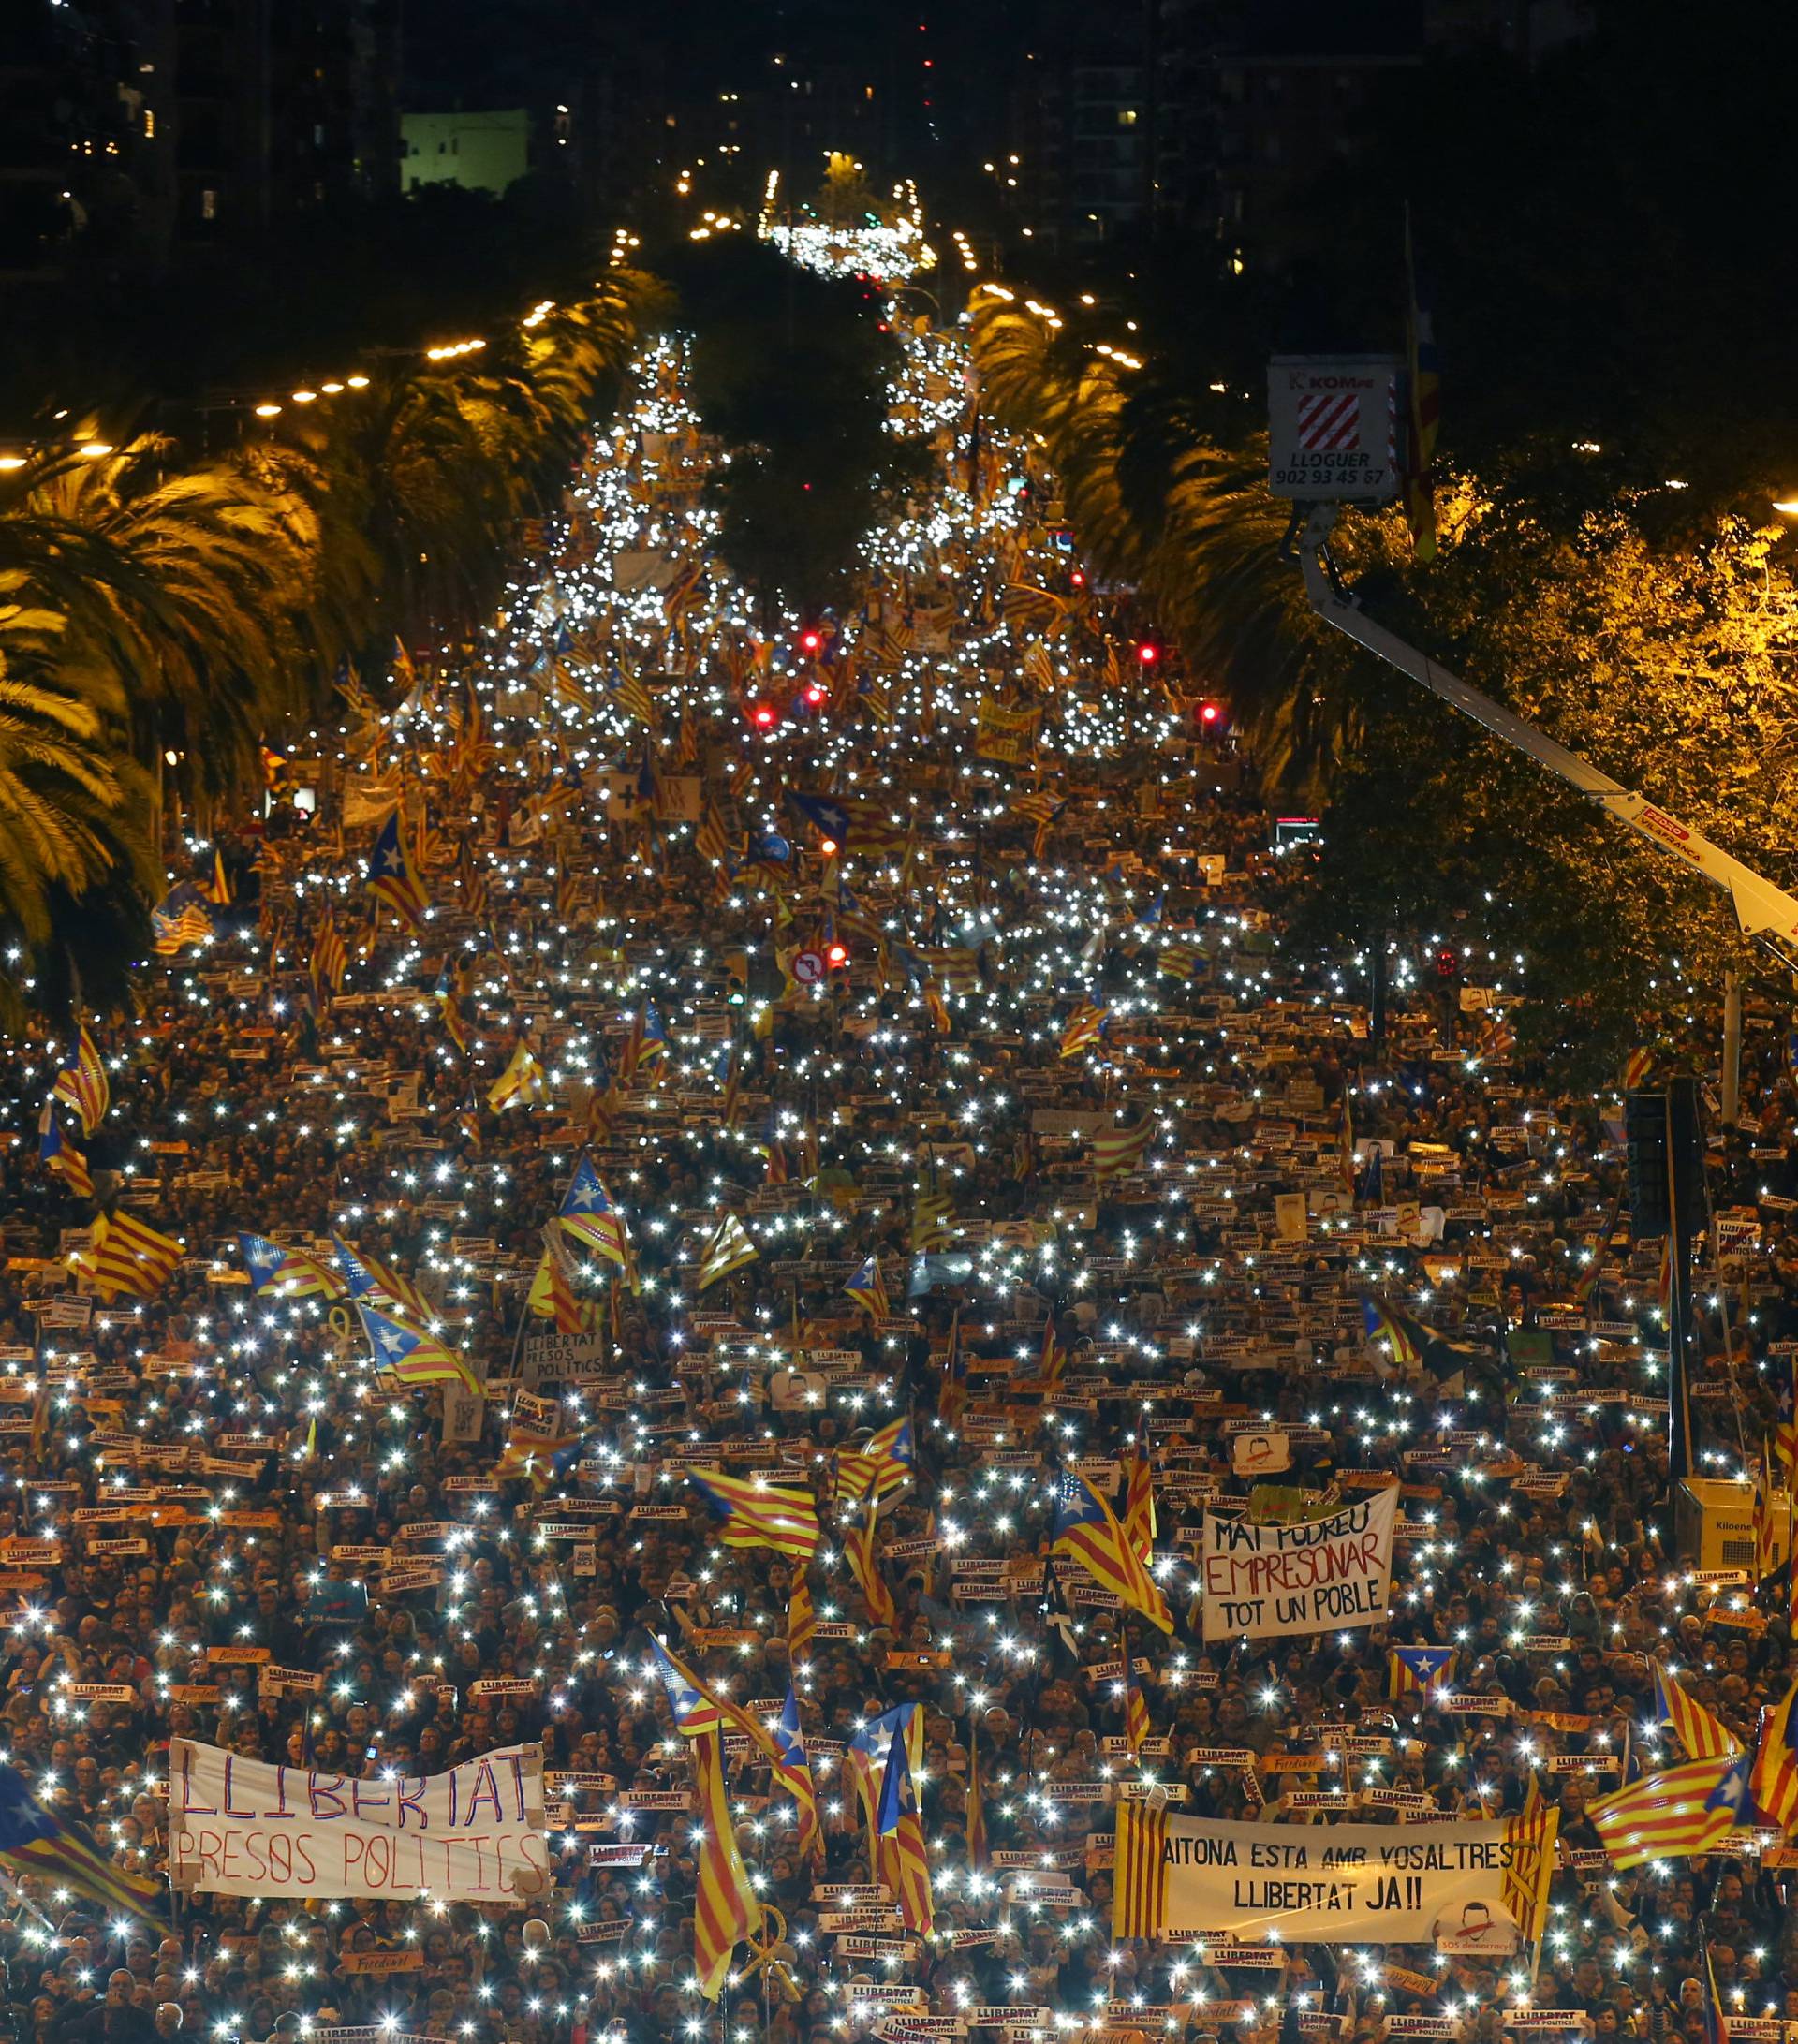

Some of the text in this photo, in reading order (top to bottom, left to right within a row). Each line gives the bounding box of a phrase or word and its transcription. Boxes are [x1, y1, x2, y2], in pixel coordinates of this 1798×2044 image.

[1290, 453, 1371, 467] LLOGUER
[1275, 470, 1306, 484] 902
[1312, 470, 1332, 484] 93
[1336, 470, 1357, 484] 45
[1647, 811, 1681, 835] PEDRO
[1641, 818, 1701, 862] VILAFRANCA
[526, 1349, 574, 1364] PRESOS
[1216, 1502, 1370, 1551] MAI PODREU
[1206, 1533, 1385, 1595] EMPRESONAR
[1219, 1579, 1382, 1628] TOT UN POBLE
[481, 1681, 531, 1689] LLIBERTAT
[1450, 1698, 1499, 1706] LLIBERTAT
[1197, 1750, 1248, 1758] LLIBERTAT
[1051, 1786, 1102, 1794] LLIBERTAT
[629, 1793, 683, 1802] LLIBERTAT
[1293, 1793, 1348, 1802] LLIBERTAT
[1372, 1790, 1424, 1803] LLIBERTAT
[1406, 1812, 1458, 1822] LLIBERTAT
[593, 1845, 645, 1856] LLIBERTAT
[1162, 1838, 1514, 1870] AITONA ESTA AMB VOSALTRES
[178, 1831, 315, 1884] PRESOS
[344, 1834, 544, 1894] POLITICS
[1235, 1876, 1422, 1910] LLIBERTAT JA!!
[1169, 1929, 1227, 1938] LLIBERTAT
[846, 1938, 906, 1951] LLIBERTAT
[1442, 1941, 1512, 1953] SOS democracy!
[1215, 1950, 1275, 1961] LLIBERTAT
[358, 1955, 408, 1970] Freedom!
[852, 1987, 916, 1997] LLIBERTAT
[977, 2007, 1039, 2019] LLIBERTAT
[1514, 2011, 1576, 2020] LLIBERTAT
[895, 2017, 956, 2027] LLIBERTAT
[1391, 2018, 1452, 2030] LLIBERTAT
